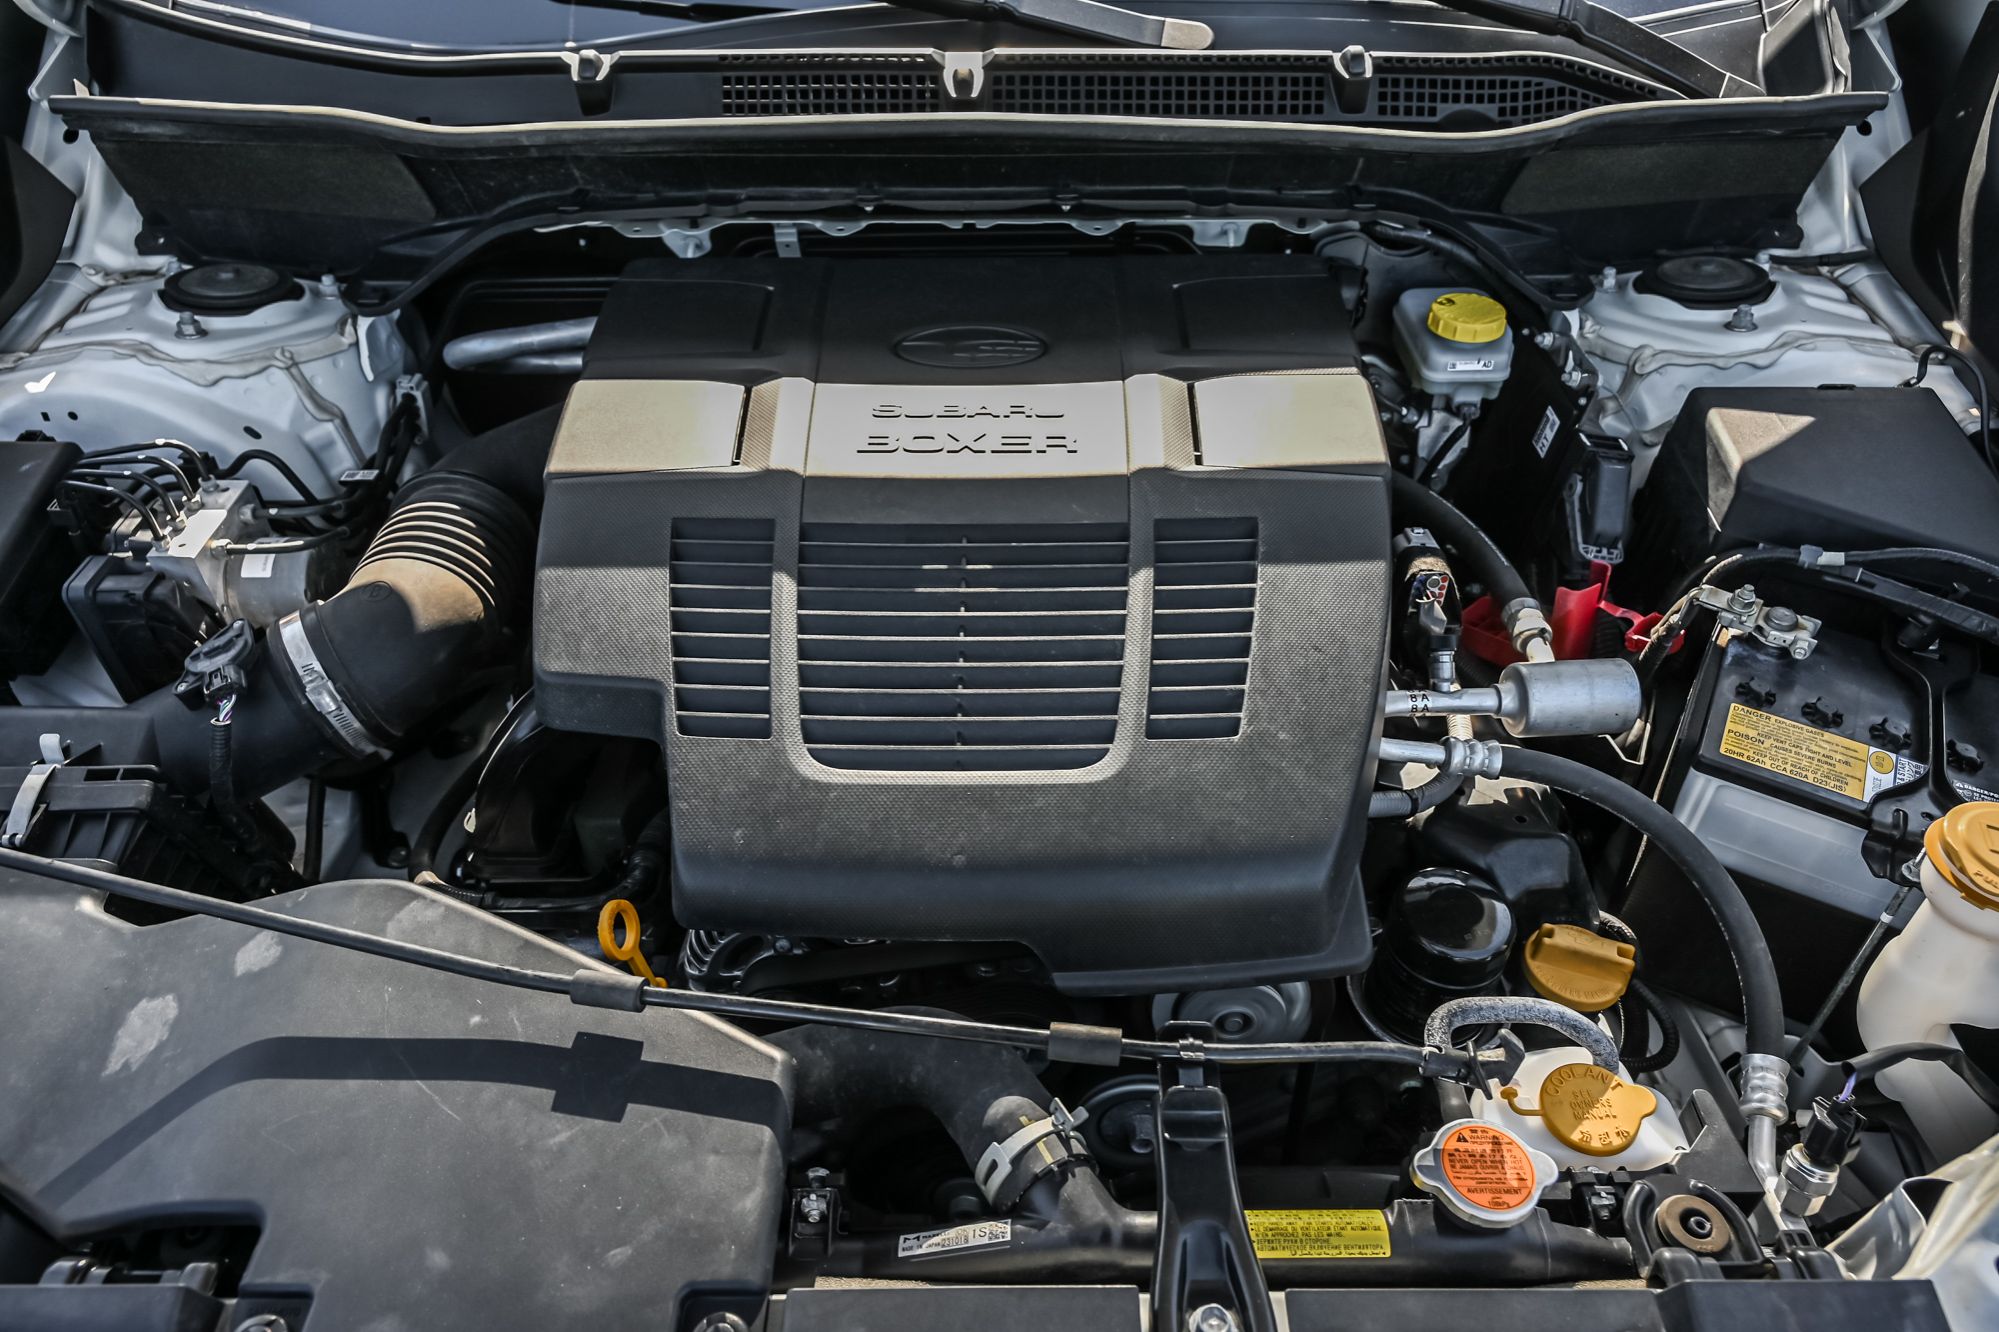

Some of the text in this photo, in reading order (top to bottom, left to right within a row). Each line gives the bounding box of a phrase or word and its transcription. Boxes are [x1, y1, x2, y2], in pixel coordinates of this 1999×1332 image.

[871, 404, 1065, 418] SUBARU
[856, 432, 1079, 453] BOXER
[1733, 705, 1772, 721] DANGER
[1774, 718, 1805, 731] EXPLOSIVE
[1805, 728, 1825, 738] GASES
[1727, 728, 1837, 769] POISON CAUSES SEVERE BURNS
[1757, 731, 1773, 740] KEEP
[1773, 737, 1787, 745] VENT
[1788, 741, 1804, 751] CAPS
[1805, 746, 1822, 757] TIGHT
[1821, 752, 1834, 761] AND
[1834, 757, 1853, 768] LEVEL
[1724, 747, 1745, 759] 20HR
[1746, 754, 1766, 766] 62Ah
[1770, 762, 1788, 774] CCA
[1789, 769, 1809, 781] 620A
[1812, 776, 1847, 793] D23(JIS)
[1752, 750, 1768, 759] KEEP
[1768, 755, 1781, 763] OUT
[1790, 762, 1811, 773] REACH
[1820, 772, 1849, 786] CHILDREN
[1545, 1066, 1624, 1096] COOLANT
[1467, 1187, 1522, 1195] AVERTISSEMENT
